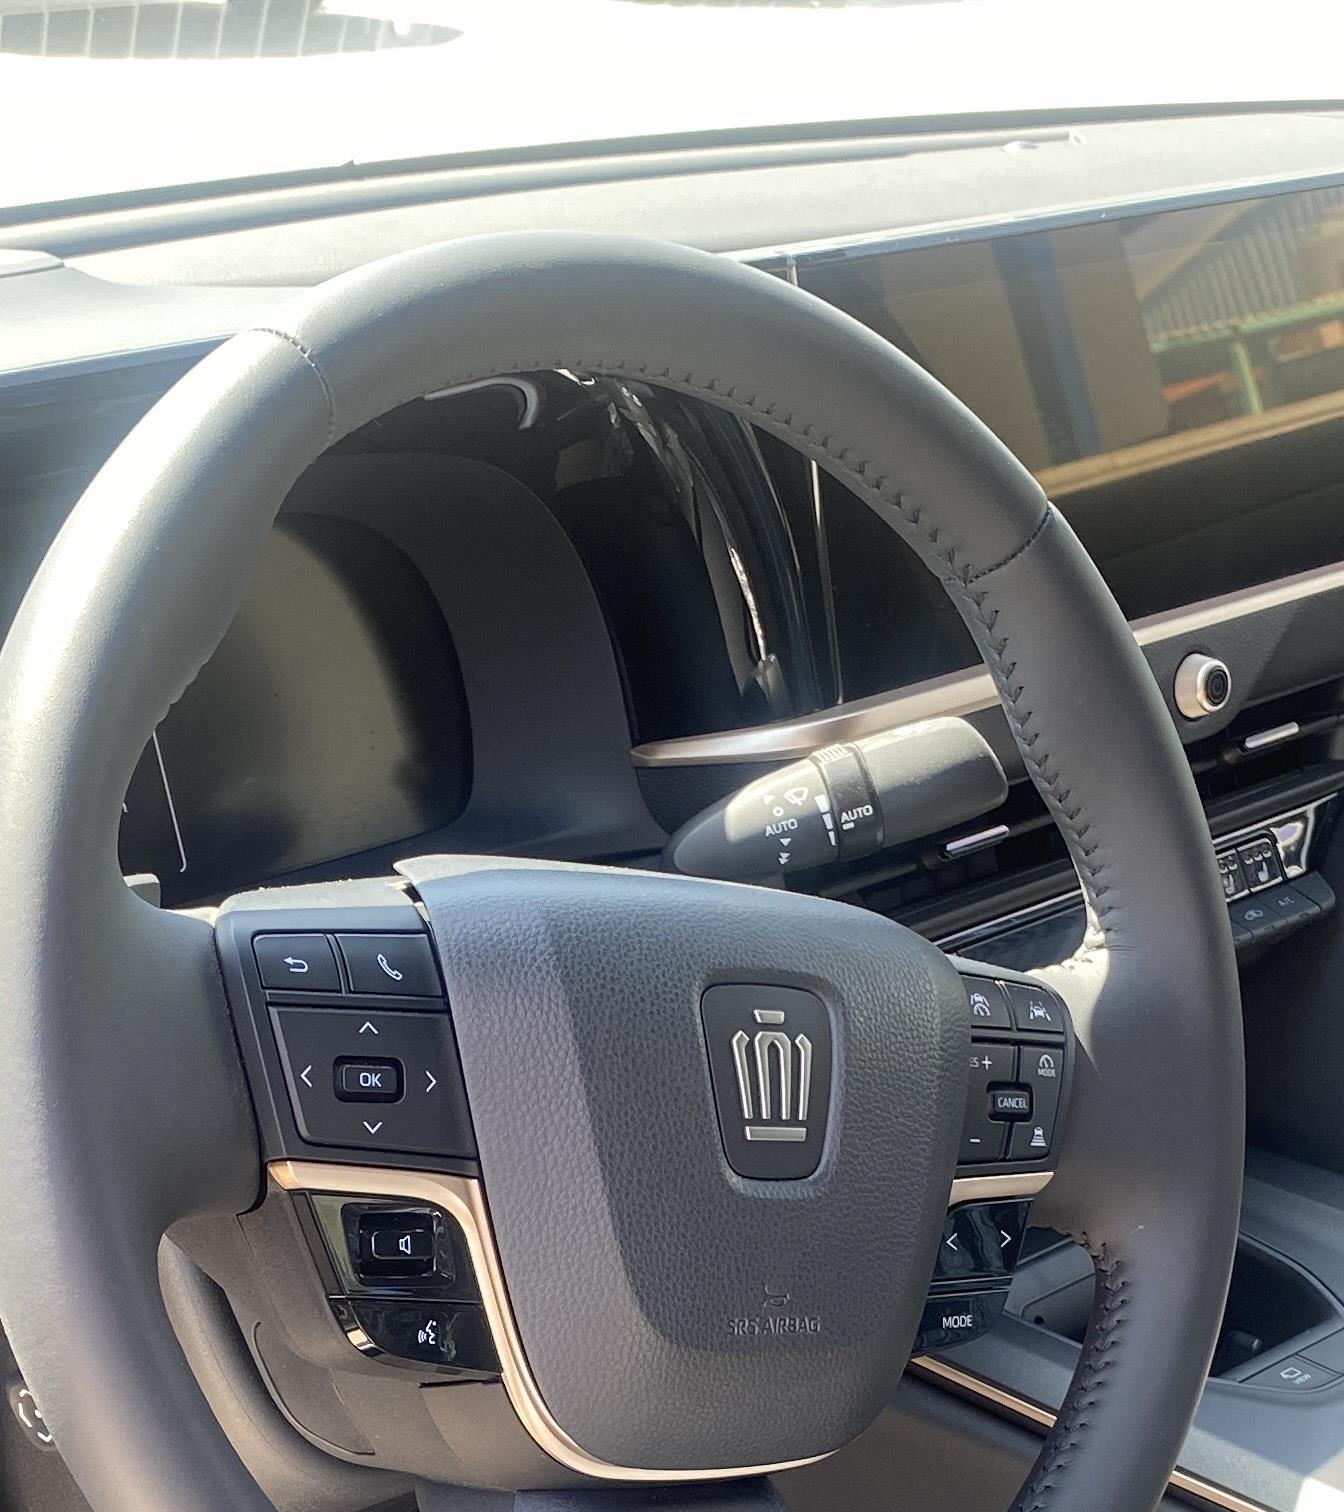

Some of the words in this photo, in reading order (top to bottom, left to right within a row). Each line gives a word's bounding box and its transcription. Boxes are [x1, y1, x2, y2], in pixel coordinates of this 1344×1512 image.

[840, 804, 874, 823] AUTO
[765, 818, 798, 837] AUTO
[359, 1072, 382, 1088] OK
[997, 1096, 1028, 1109] CANCEL
[763, 1316, 821, 1335] AIRBAG
[942, 1314, 973, 1329] MODE
